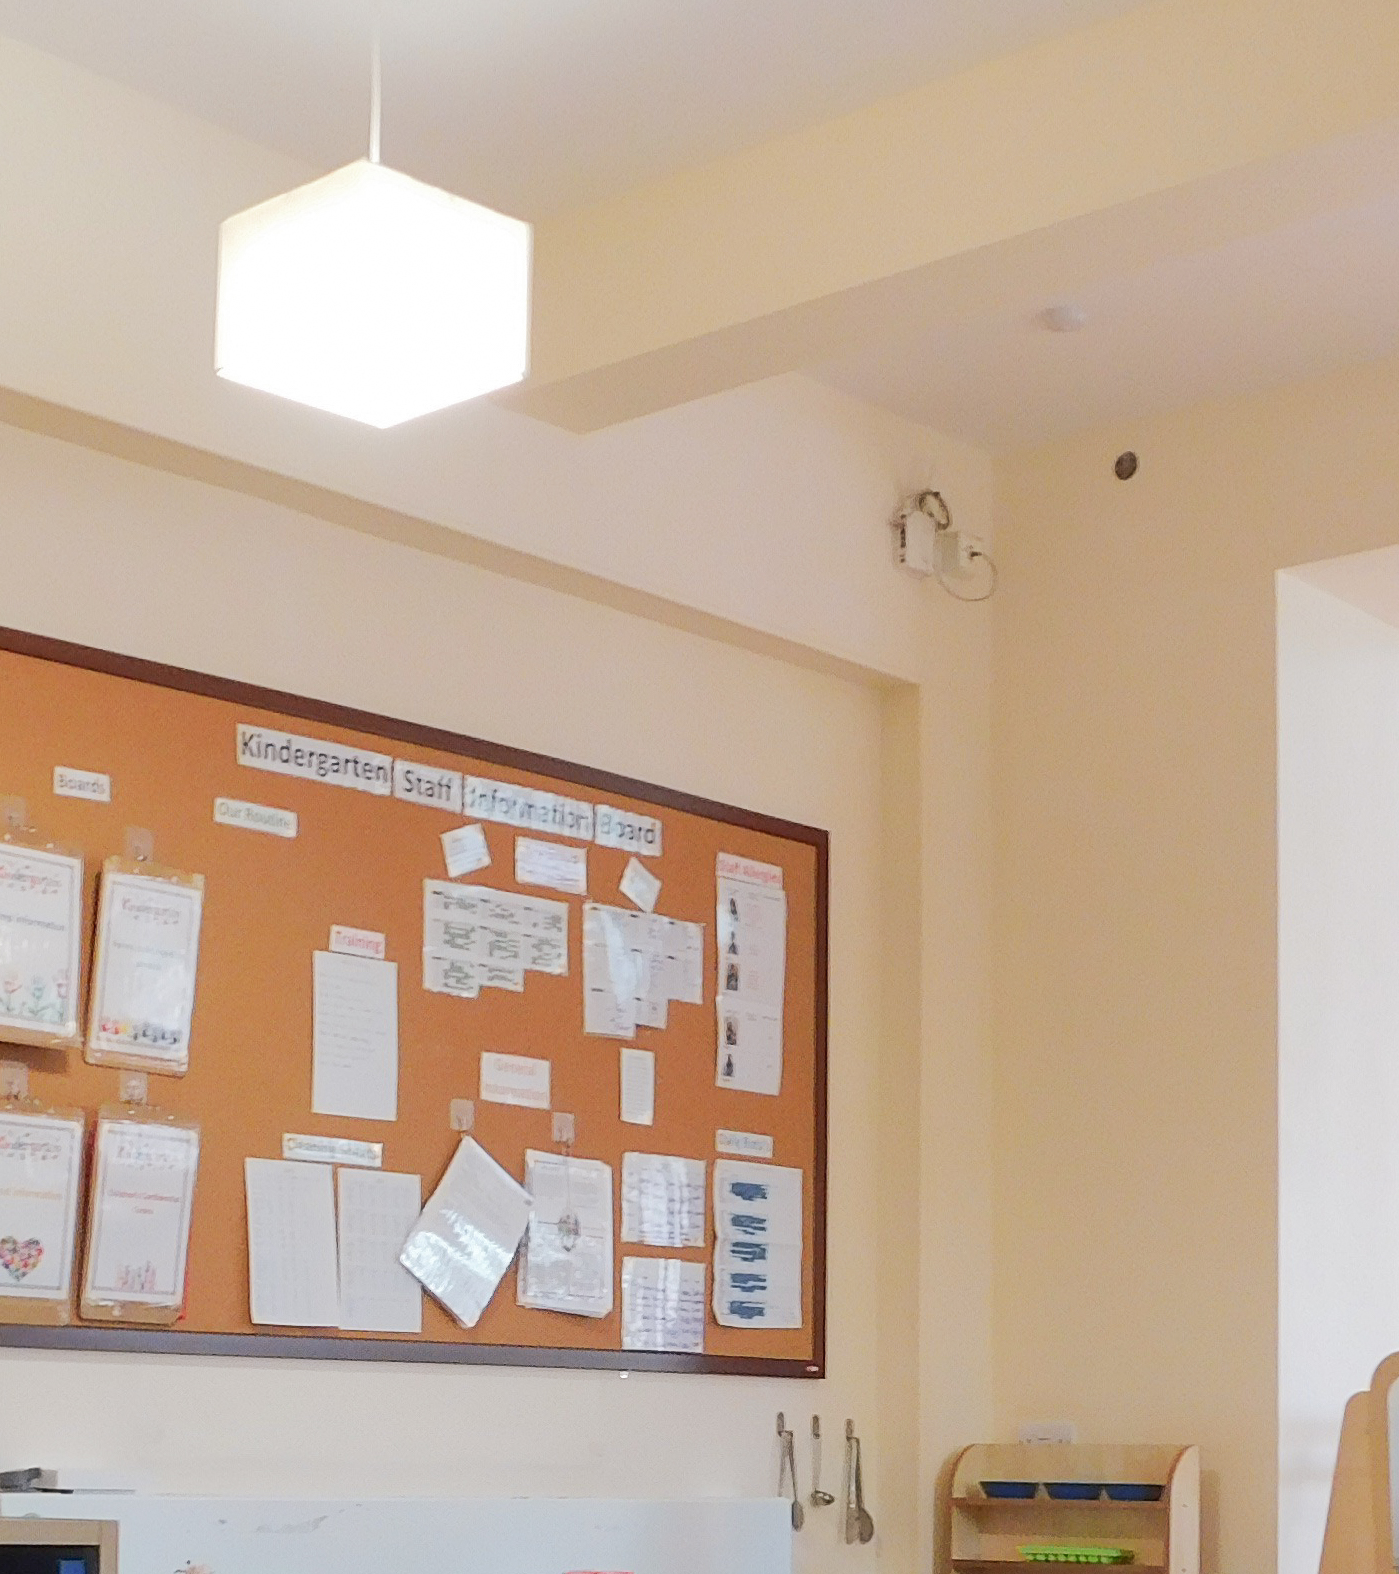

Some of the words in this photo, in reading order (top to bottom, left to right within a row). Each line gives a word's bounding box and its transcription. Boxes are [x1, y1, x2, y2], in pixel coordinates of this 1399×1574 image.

[242, 731, 388, 783] Kindergarten
[404, 770, 451, 801] Staff
[469, 786, 589, 831] Information
[601, 812, 656, 844] Board
